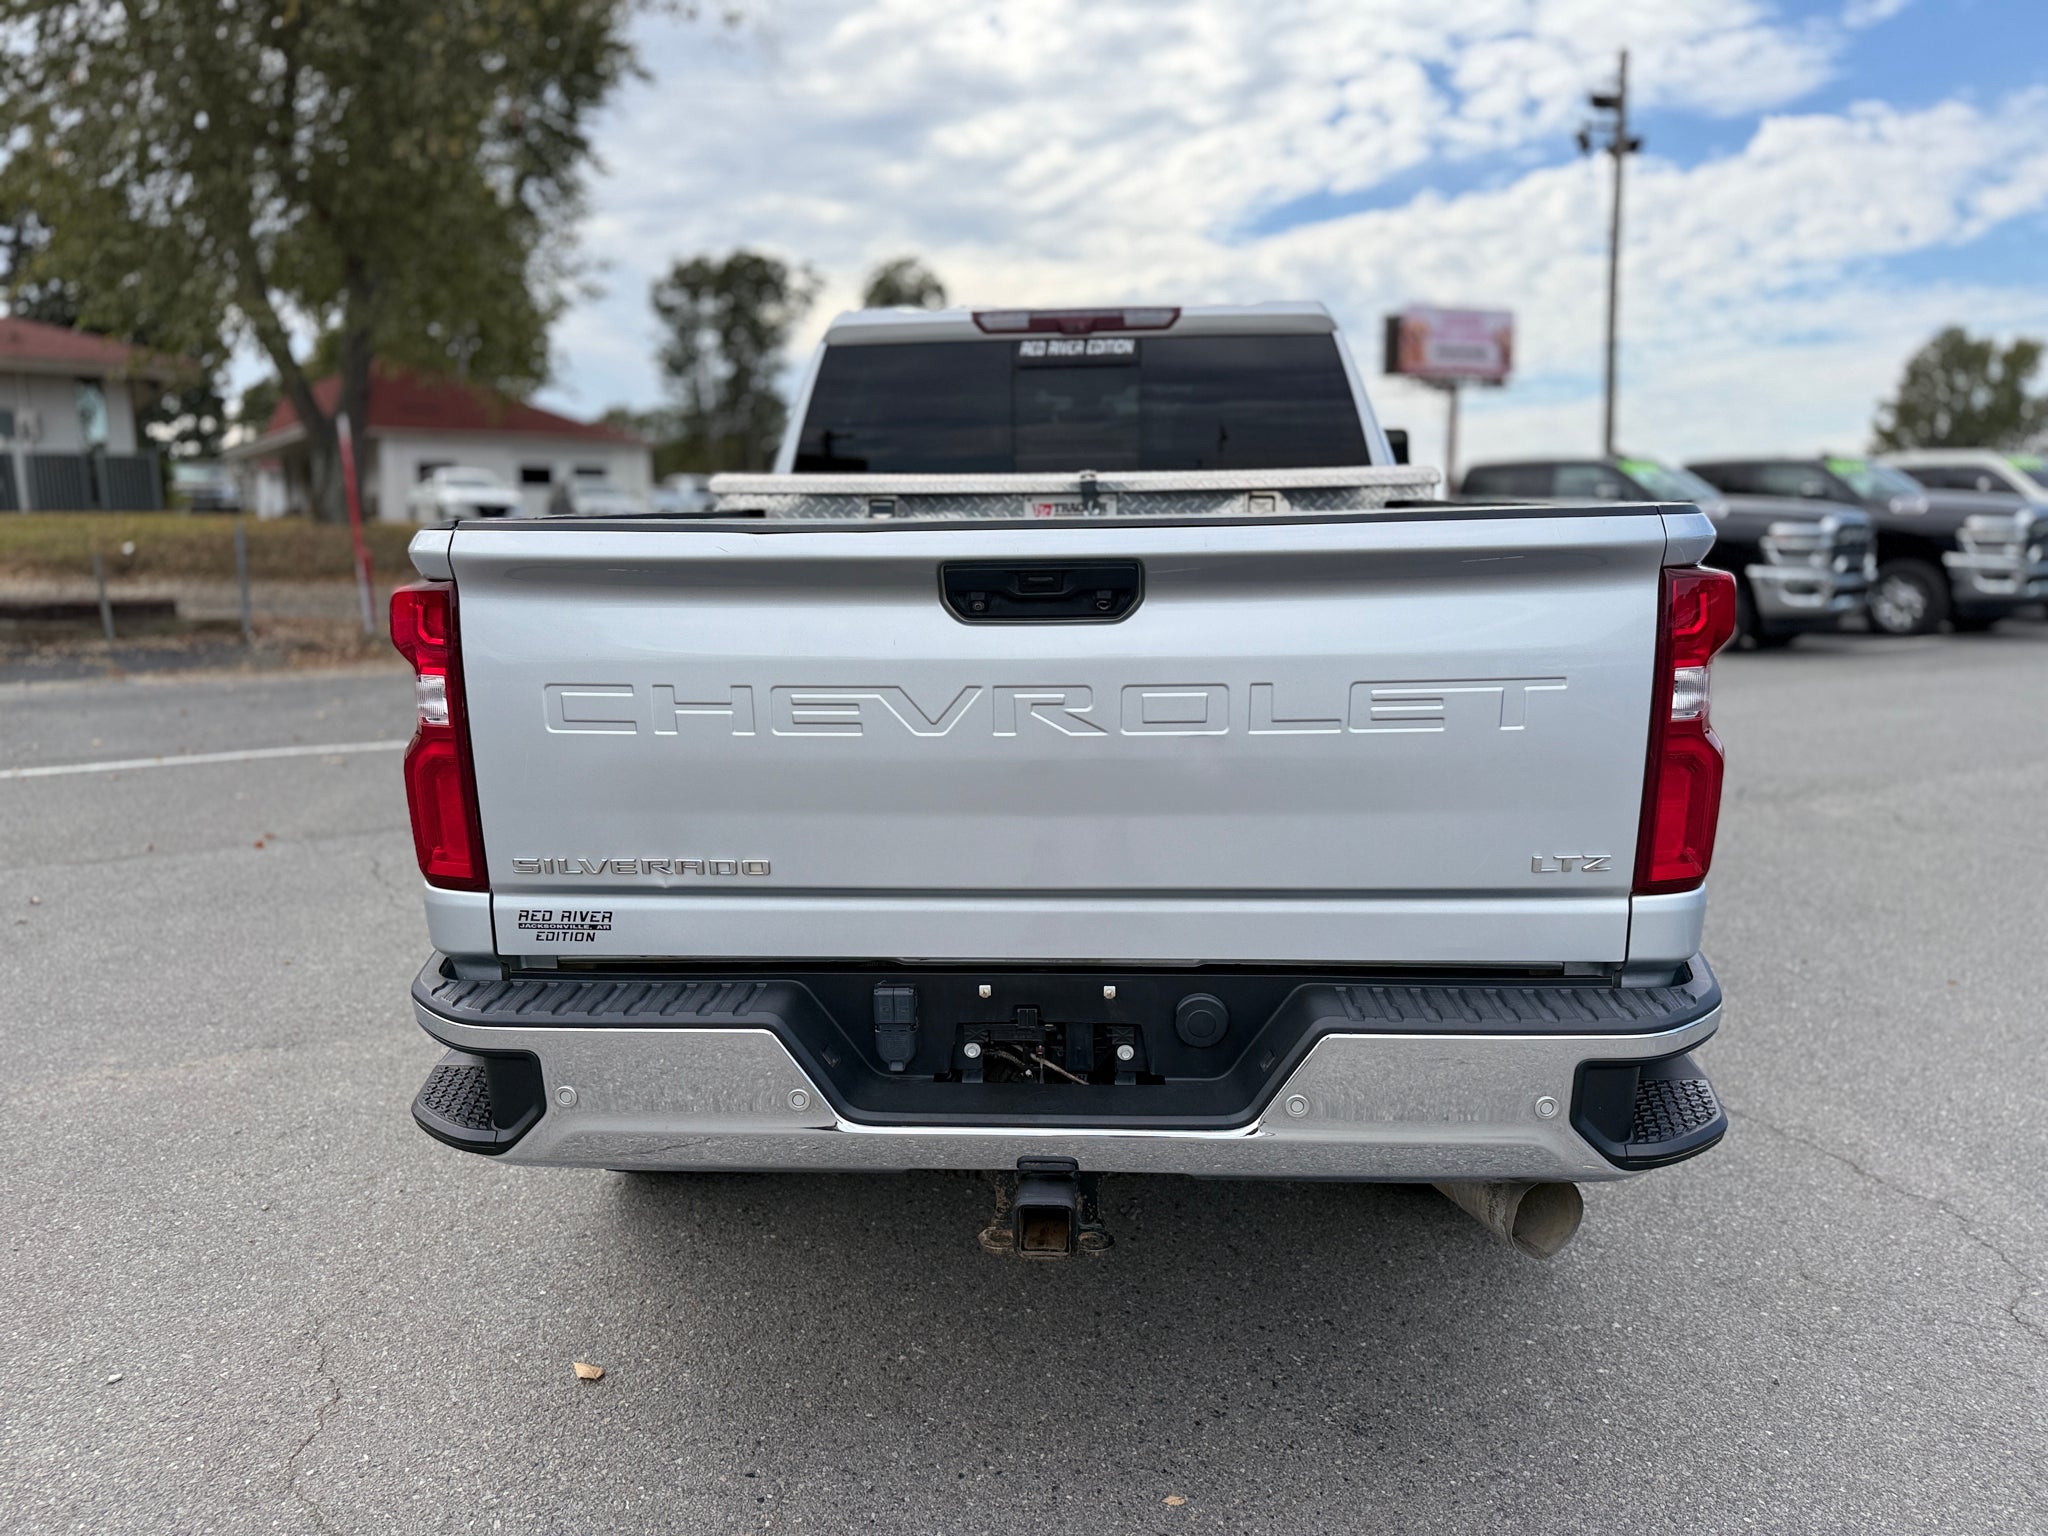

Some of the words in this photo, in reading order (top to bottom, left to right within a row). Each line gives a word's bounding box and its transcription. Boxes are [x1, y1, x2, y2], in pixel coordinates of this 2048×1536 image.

[1019, 340, 1046, 357] RED
[1047, 340, 1085, 356] RIVER
[1085, 338, 1135, 355] EDITION
[543, 676, 1568, 737] CHEVROLET
[511, 857, 771, 876] SILVERADO
[1531, 854, 1612, 873] LTZ
[518, 909, 553, 922] RED
[560, 910, 613, 923] RIVER
[535, 931, 596, 942] EDITION
